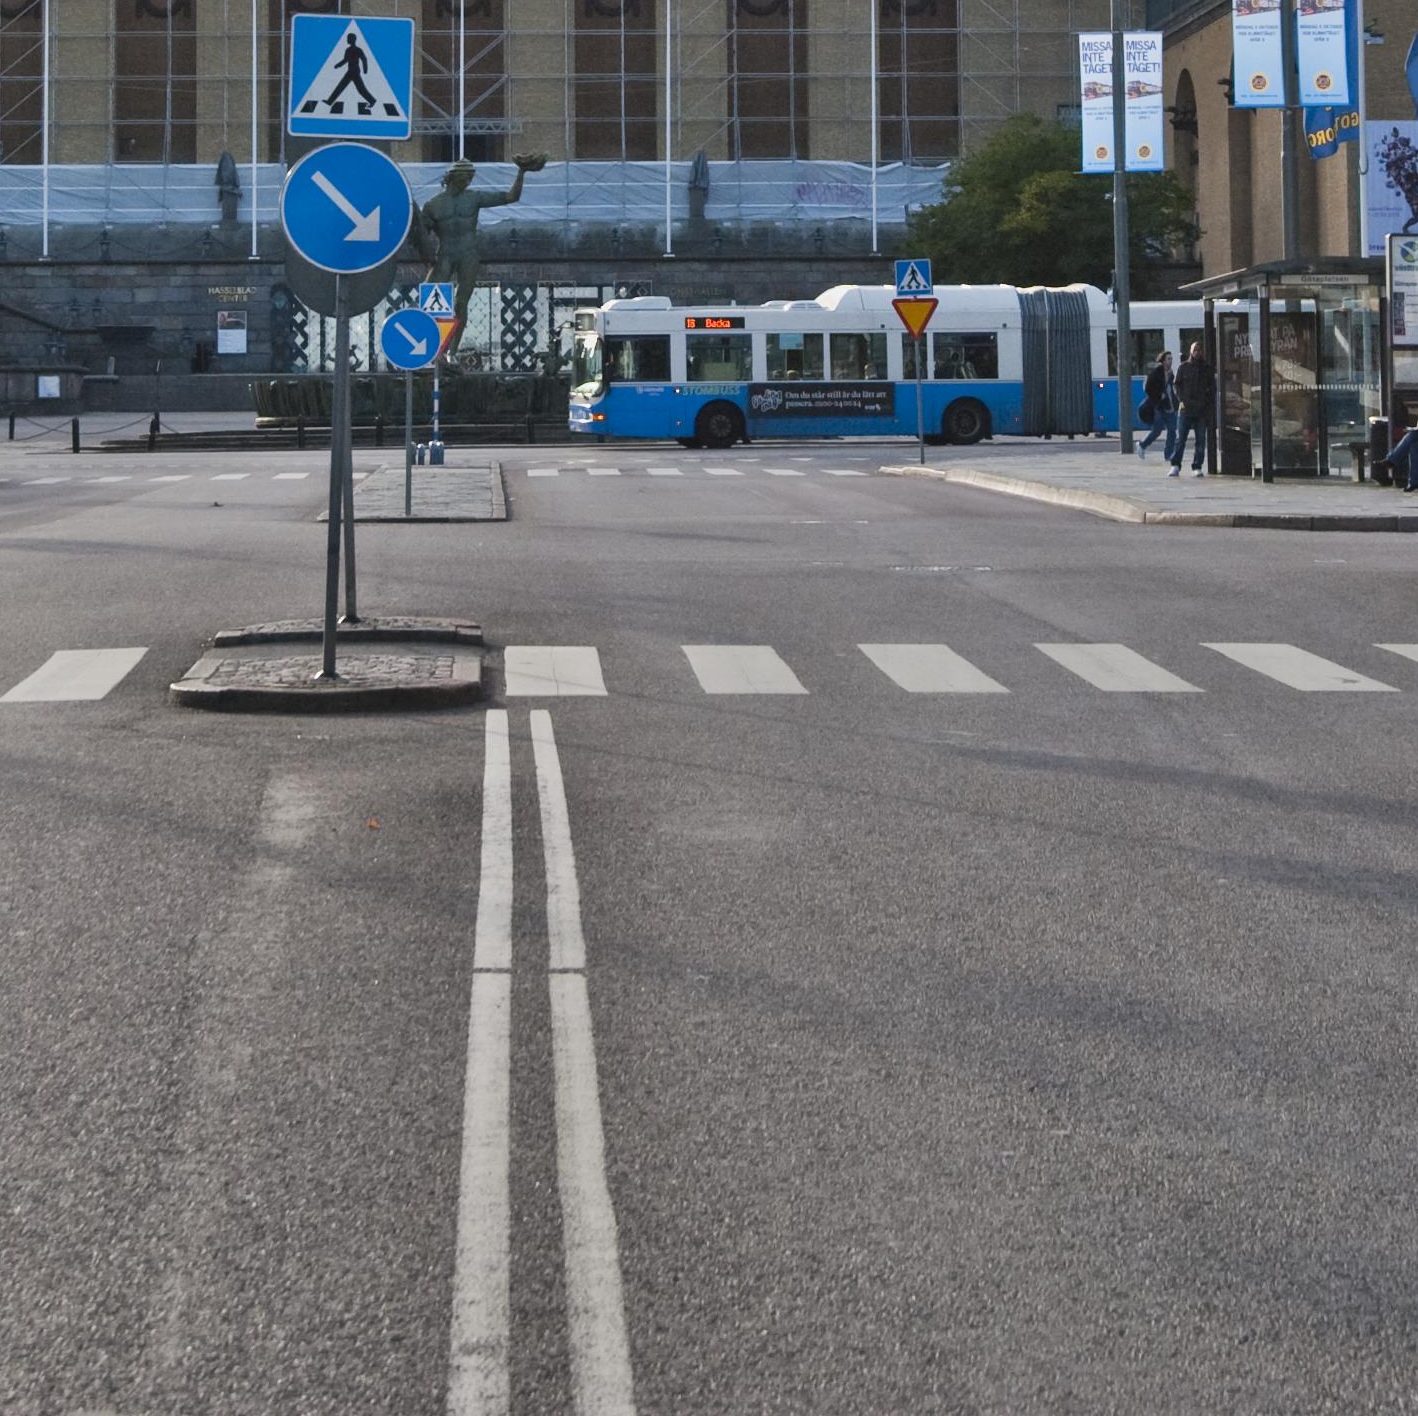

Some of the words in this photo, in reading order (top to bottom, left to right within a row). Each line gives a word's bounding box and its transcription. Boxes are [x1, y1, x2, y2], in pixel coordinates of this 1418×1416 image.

[1082, 42, 1112, 51] MISSA
[1126, 40, 1157, 50] MISSA
[1082, 52, 1105, 62] INTE
[1126, 51, 1148, 61] INTE
[706, 317, 731, 328] Backa
